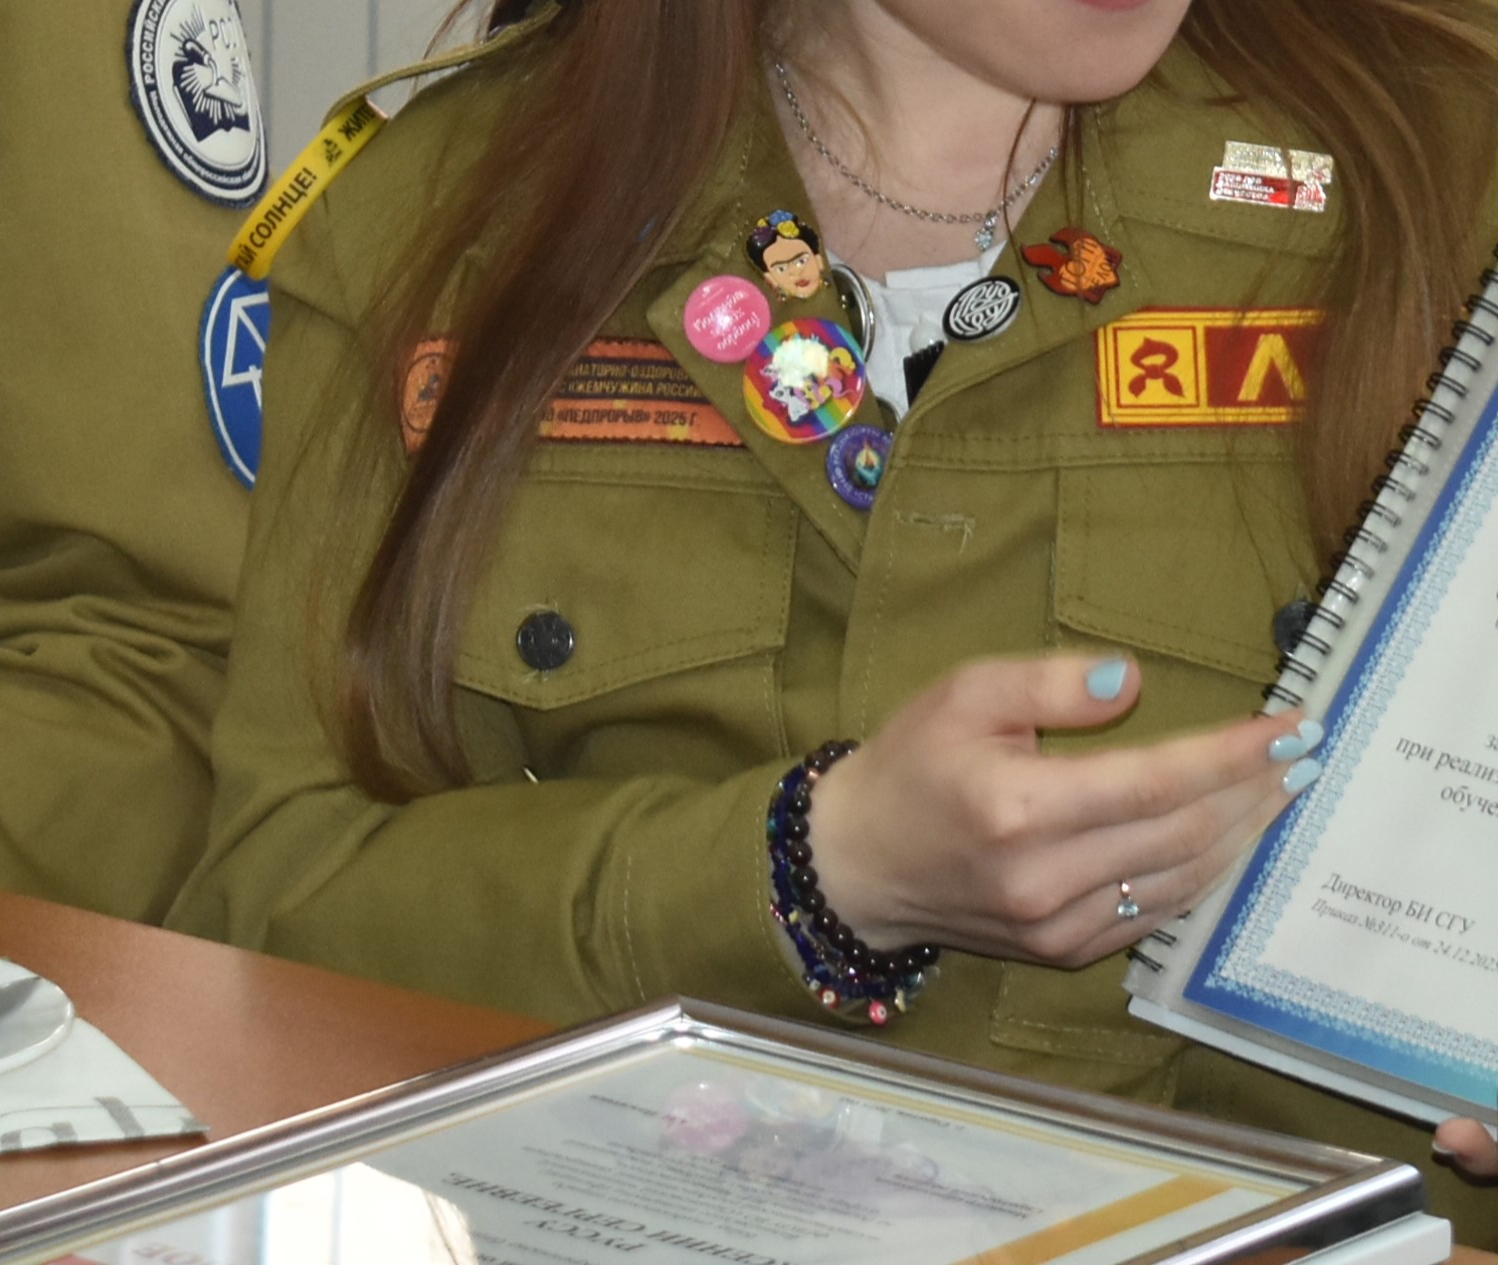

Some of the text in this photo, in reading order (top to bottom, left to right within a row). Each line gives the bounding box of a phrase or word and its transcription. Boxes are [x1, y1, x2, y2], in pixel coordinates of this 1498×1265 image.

[249, 166, 318, 249] СОЛНЦЕ!
[1396, 738, 1433, 761] при
[1311, 899, 1359, 924] Приказ
[1411, 938, 1431, 949] от
[1322, 874, 1472, 934] Директор БИ СГУ
[442, 1172, 646, 1234] СЕРГЕЕВНЕ,
[524, 1217, 646, 1253] РУССУ
